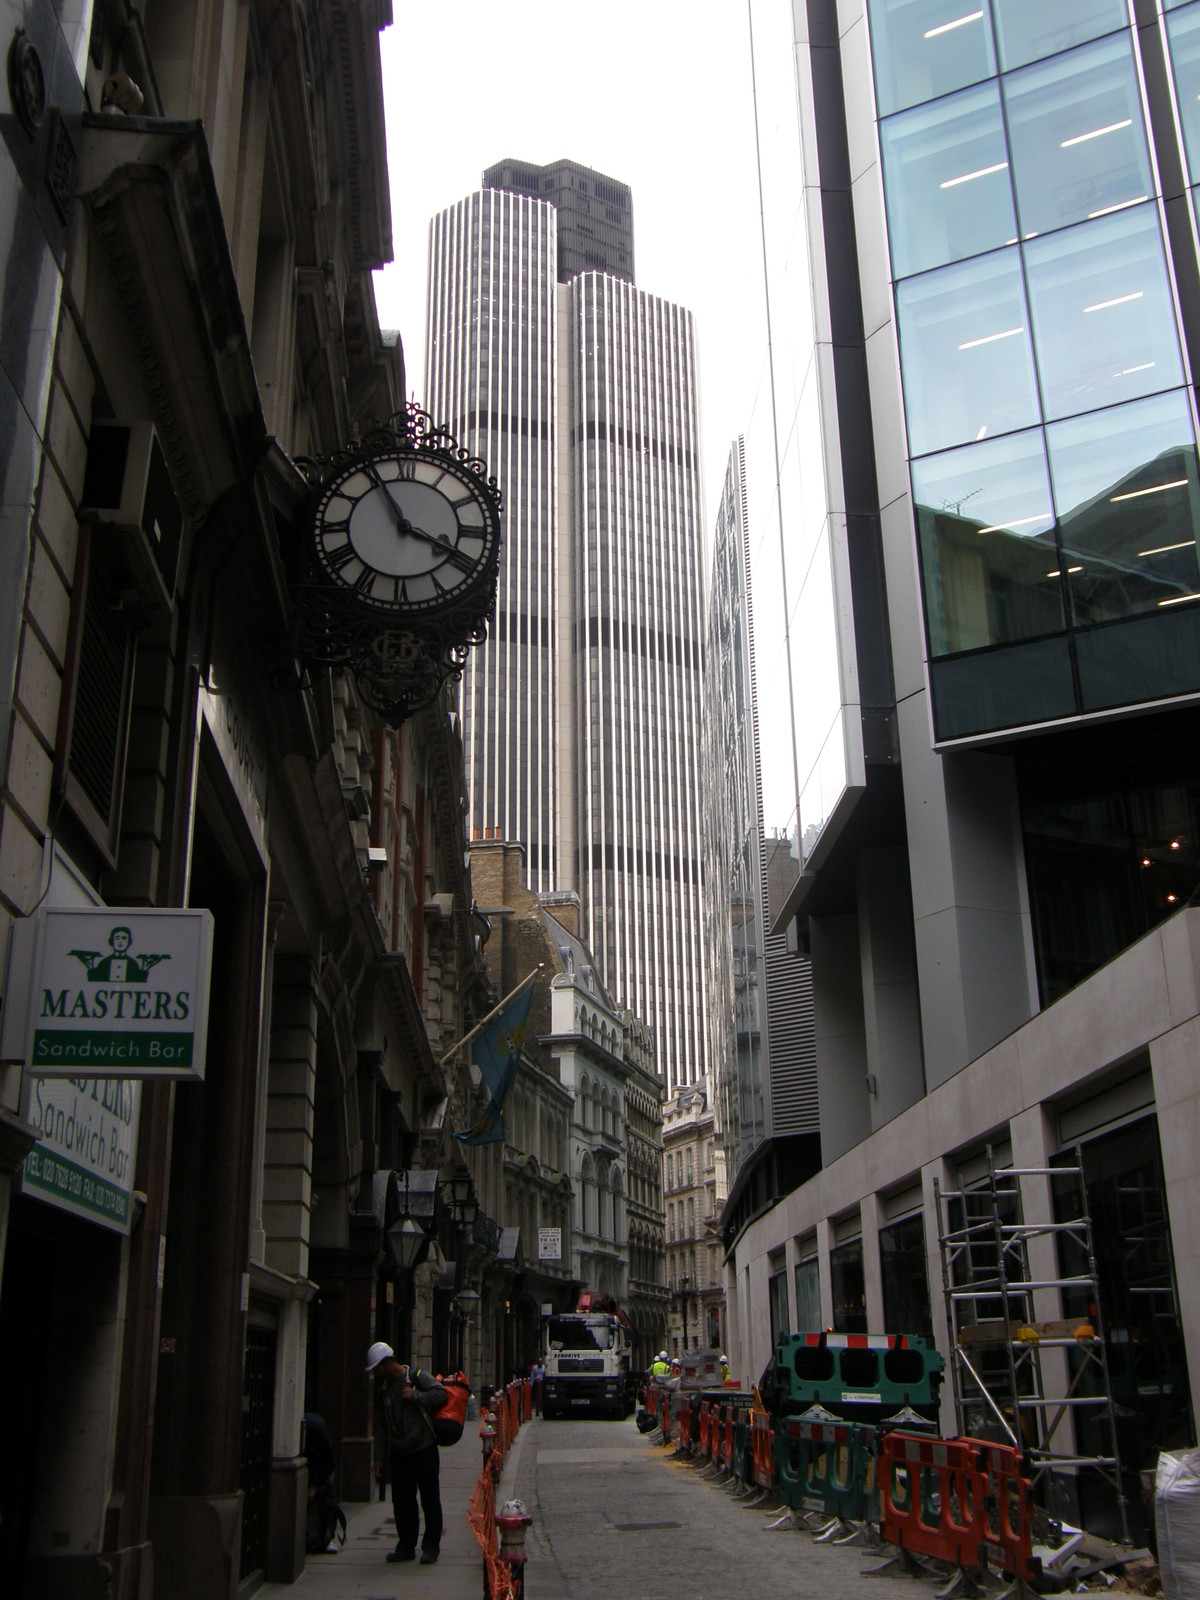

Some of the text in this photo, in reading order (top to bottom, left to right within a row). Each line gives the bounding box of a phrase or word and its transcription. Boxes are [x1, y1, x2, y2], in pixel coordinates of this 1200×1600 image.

[40, 988, 190, 1021] MASTERS
[37, 1039, 186, 1059] Sandwich Bar
[32, 1079, 129, 1180] Sandwich Bar
[43, 1158, 55, 1183] 020
